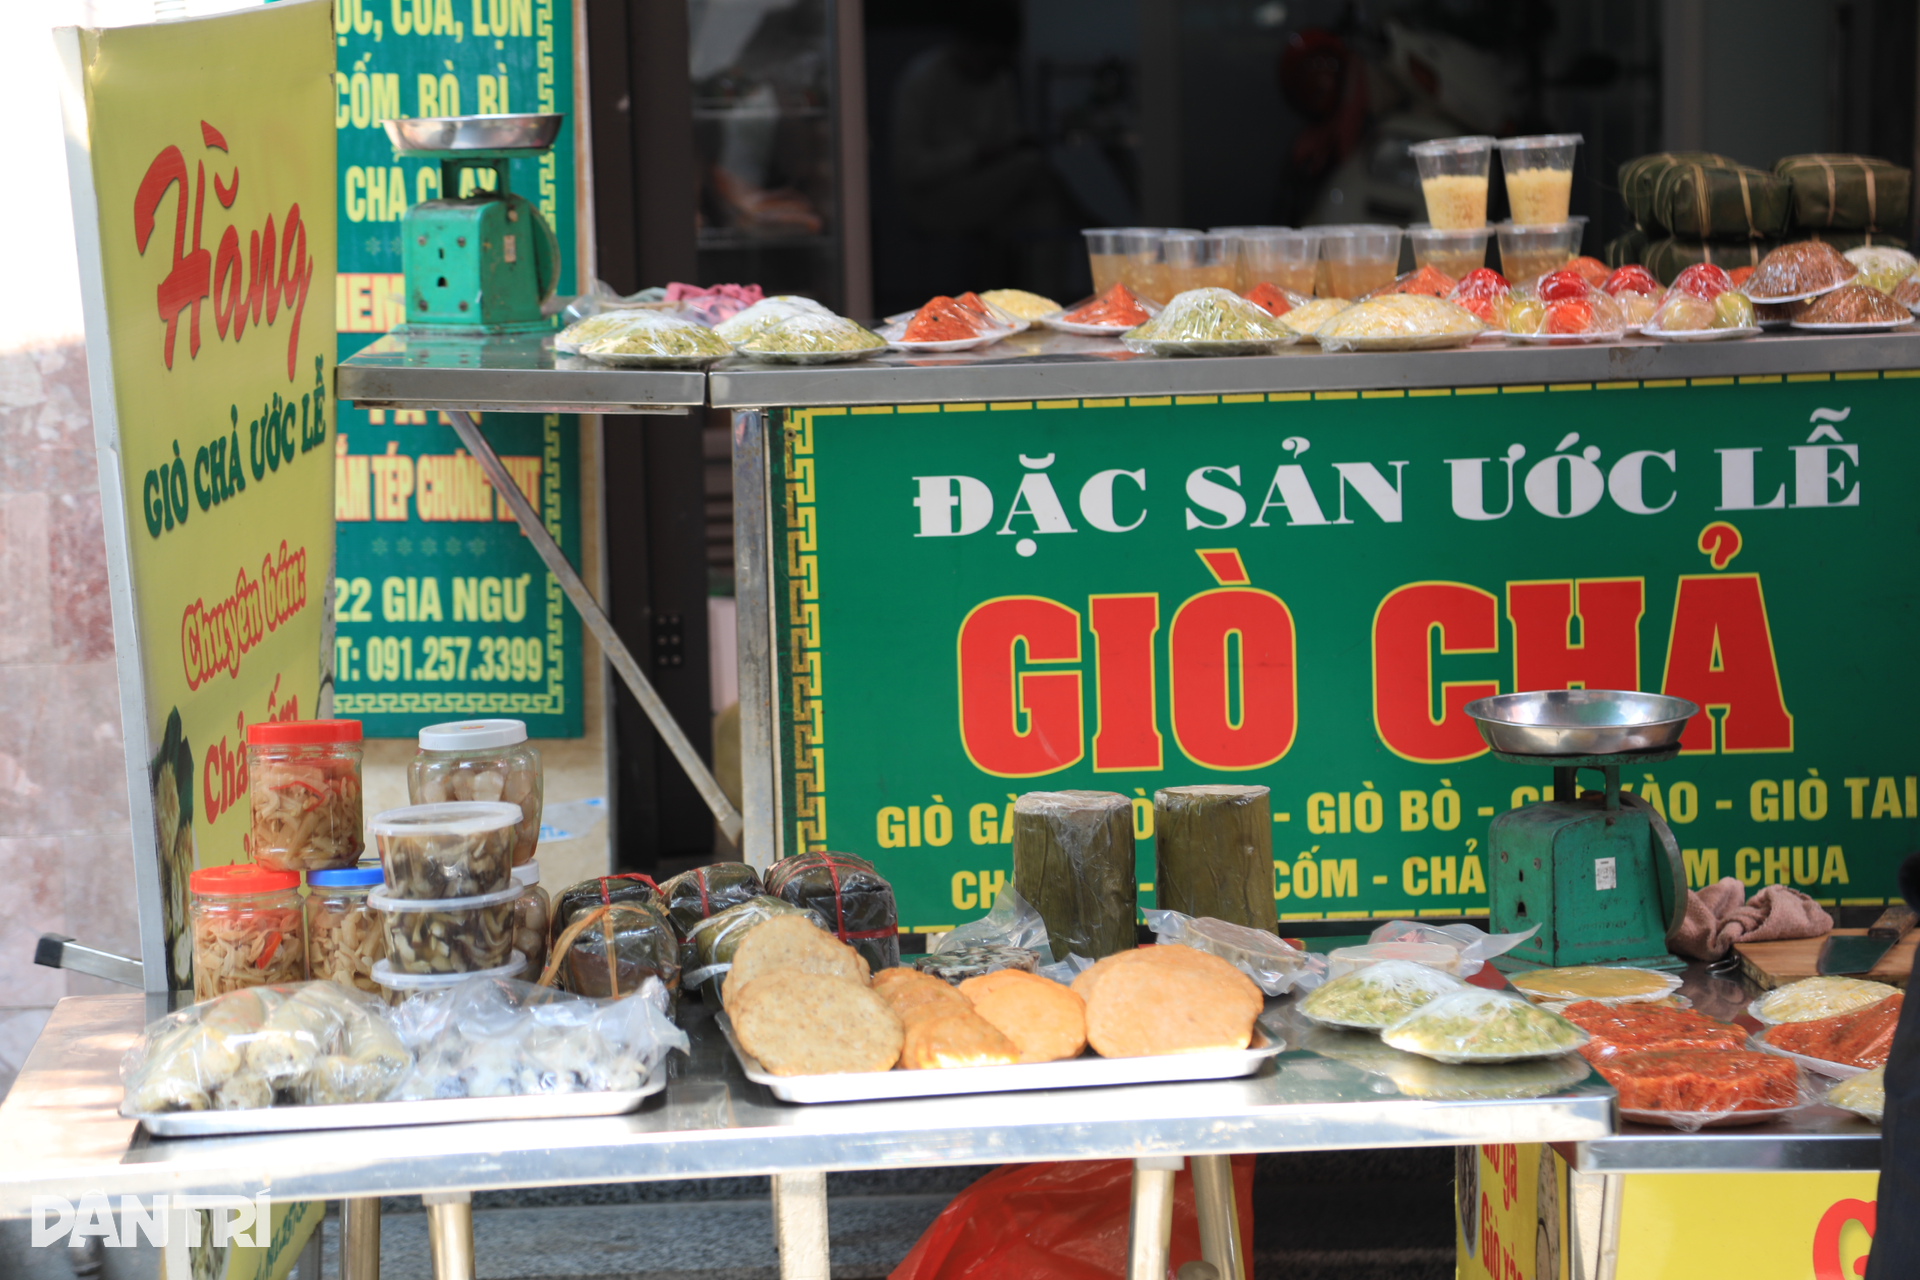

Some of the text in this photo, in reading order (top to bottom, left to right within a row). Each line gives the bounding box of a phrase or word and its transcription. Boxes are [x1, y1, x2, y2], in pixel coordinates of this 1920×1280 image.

[336, 52, 409, 129] CỐM
[143, 353, 326, 539] GIÒ CHẢ ƯỚC LỄ
[371, 441, 415, 521] TÉP
[912, 407, 1861, 557] ĐẶC SẢN ƯỚC LỄ
[182, 539, 306, 692] Chuyên bán:
[382, 576, 443, 622] GIA
[452, 573, 531, 622] NGƯ
[334, 636, 543, 682] T: 091.257.3399
[957, 520, 1794, 779] GIÒ CHẢ
[876, 795, 953, 849] GIÒ
[1306, 780, 1384, 835] GIÒ
[1400, 778, 1461, 832] BÒ
[1750, 767, 1828, 823] GIÒ
[1844, 776, 1917, 819] TAI
[951, 870, 1014, 911] CH
[1274, 845, 1358, 900] CỐM
[1402, 838, 1486, 896] CHẢ
[1735, 844, 1850, 887] CHUA
